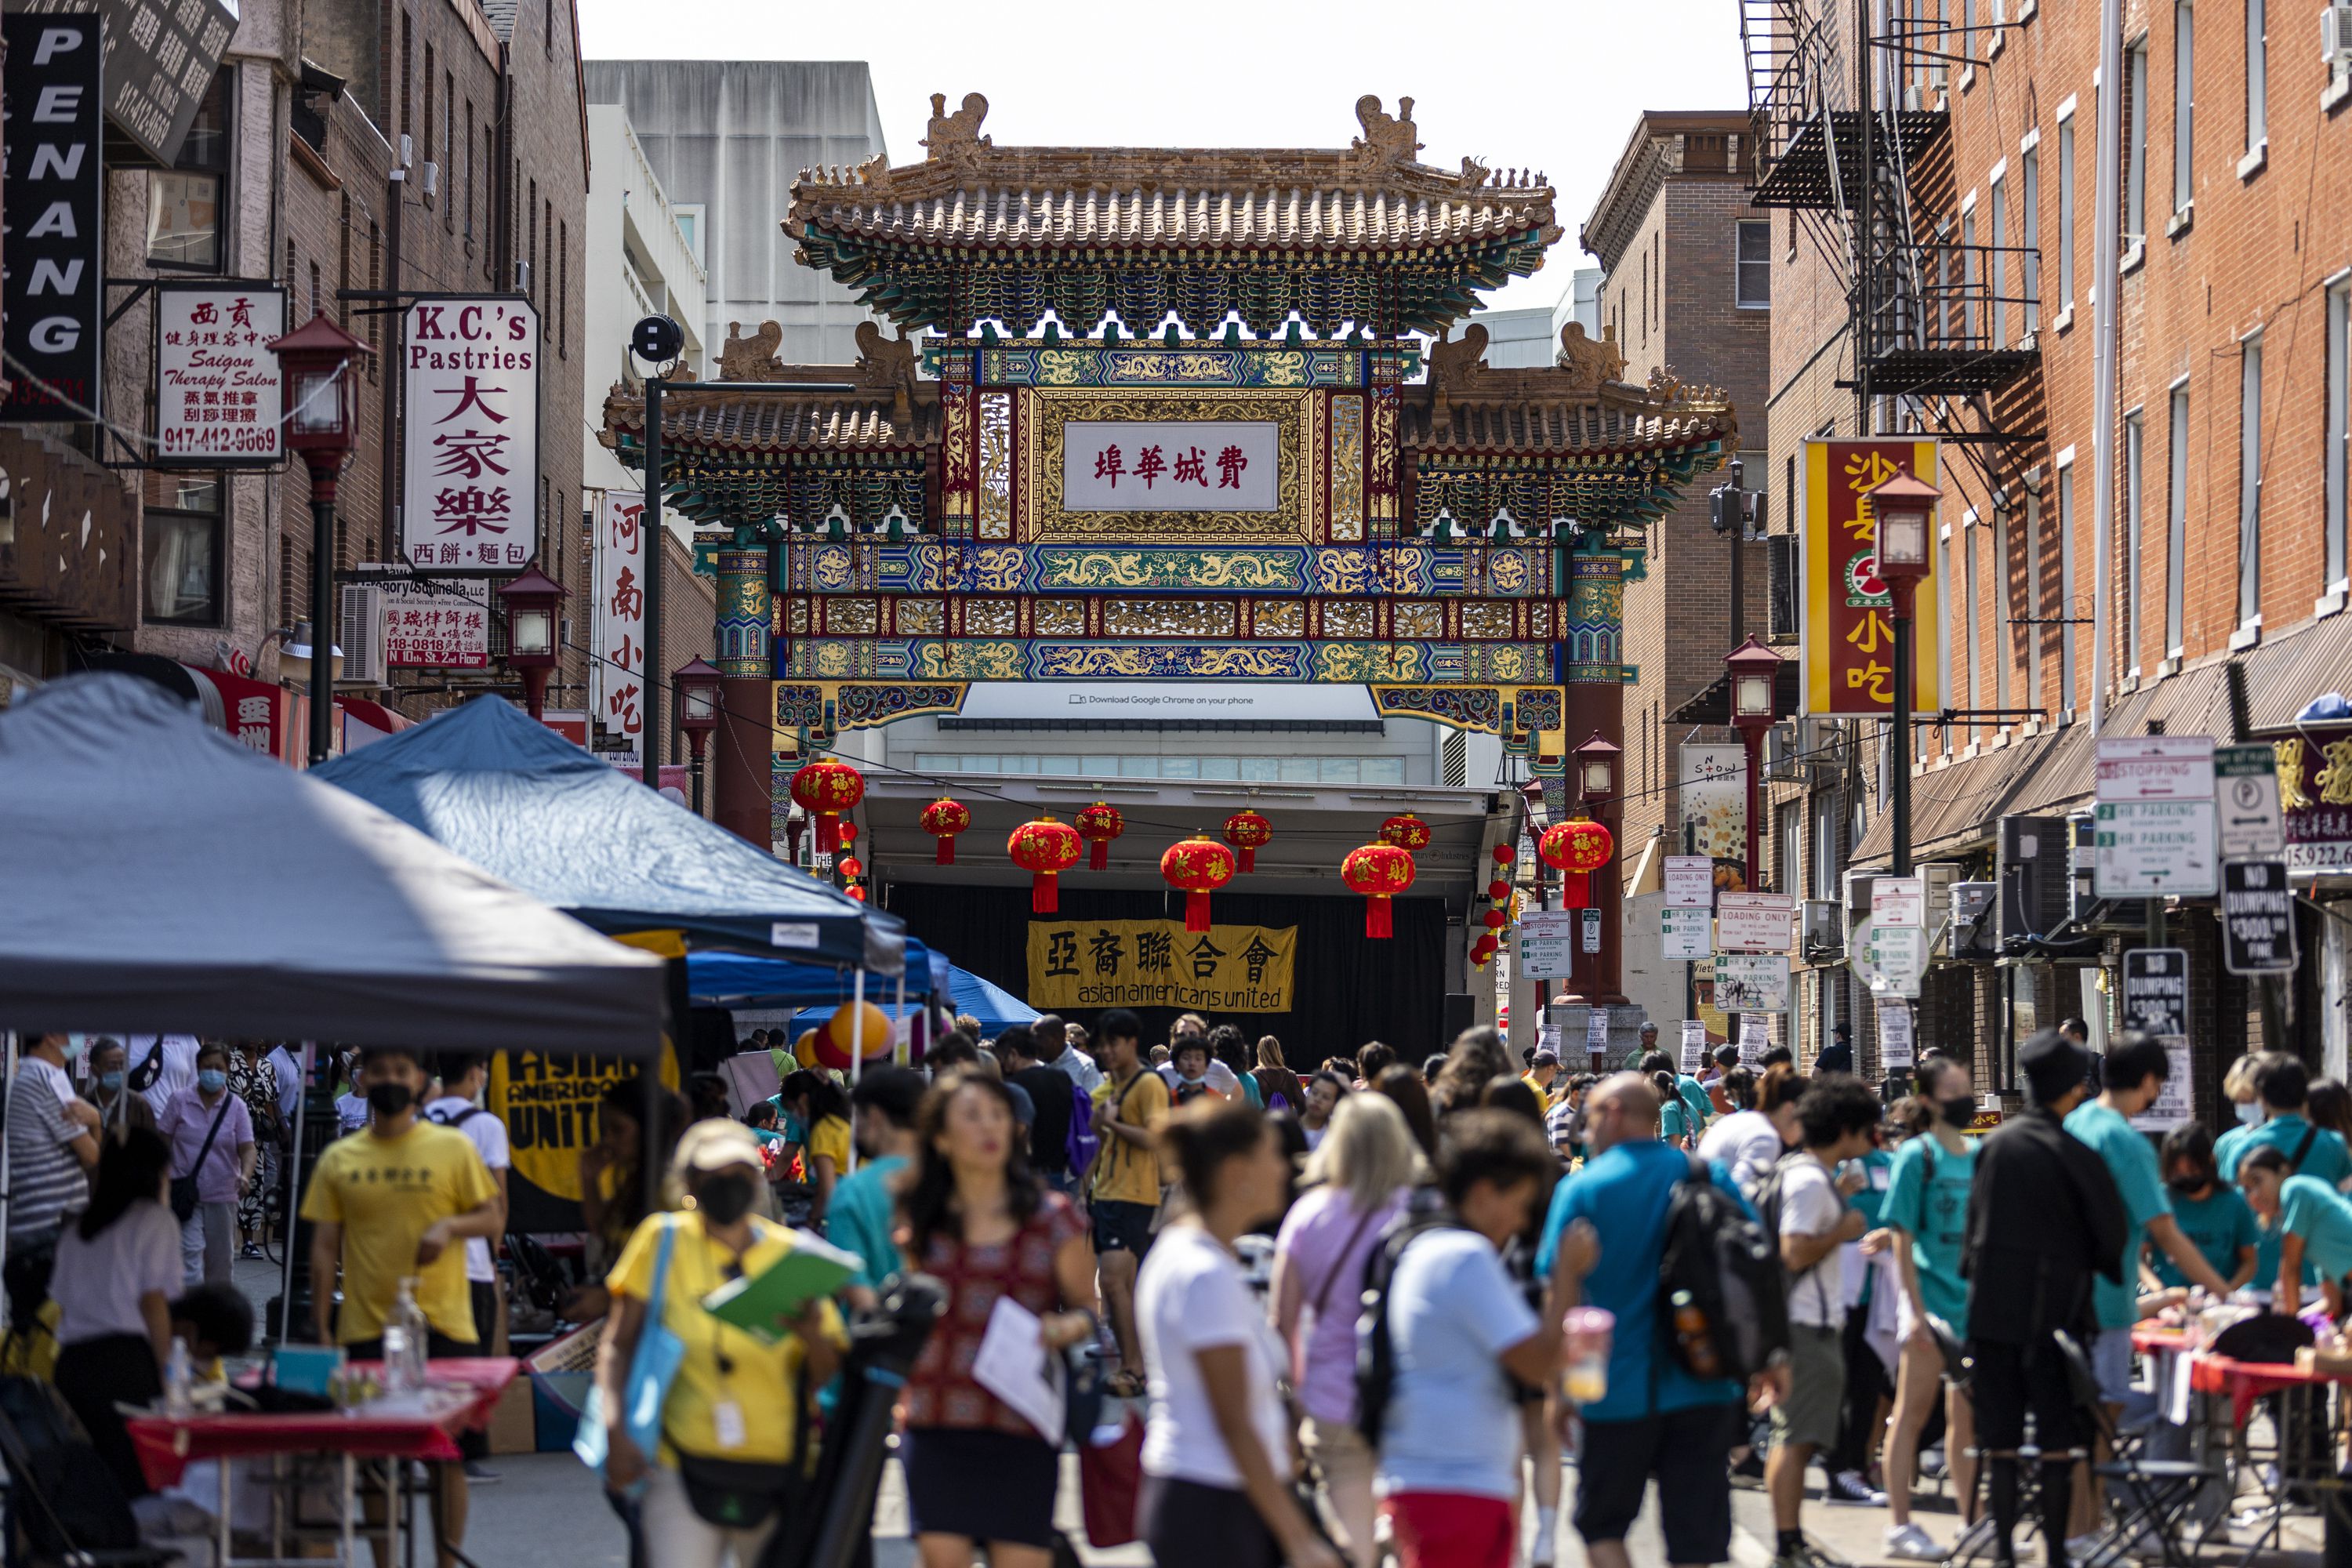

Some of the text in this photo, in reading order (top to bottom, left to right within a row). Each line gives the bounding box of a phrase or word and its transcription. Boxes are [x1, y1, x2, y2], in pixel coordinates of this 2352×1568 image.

[115, 81, 171, 149] 917-412-9669
[27, 28, 86, 354] PENANG
[191, 298, 255, 328] 西貢
[416, 306, 526, 341] K.C.'s
[165, 330, 279, 347] 健身理容中心
[188, 350, 255, 373] Saigon
[410, 346, 532, 370] Pastries
[165, 369, 278, 390] Therapy Salon
[184, 391, 258, 405] 蒸氣推拿
[184, 408, 257, 423] 刮痧理療
[165, 427, 275, 452] 917-412-9669
[431, 376, 511, 537] 大家樂
[416, 598, 437, 607] Security
[470, 587, 485, 597] LLC
[610, 503, 644, 734] 河南小吃
[390, 651, 481, 664] N 10th St. 2nd Floor
[1089, 695, 1130, 704] Download
[1131, 696, 1160, 706] Google
[1162, 695, 1195, 704] Chrome
[1208, 697, 1226, 706] your
[1228, 697, 1254, 706] phone
[2120, 764, 2191, 777] STOPPING
[2140, 804, 2196, 817] PARKING
[2140, 832, 2197, 844] PARKING
[2227, 891, 2286, 914] DUMPING
[1723, 912, 1761, 920] LOADING
[1044, 929, 1279, 985] 亞裔聯合會
[1078, 982, 1281, 1008] asian americans united
[2129, 977, 2183, 996] DUMPING
[507, 1080, 614, 1102] AMERICA
[508, 1102, 600, 1150] UNIT
[1974, 1113, 1998, 1125] 小吃
